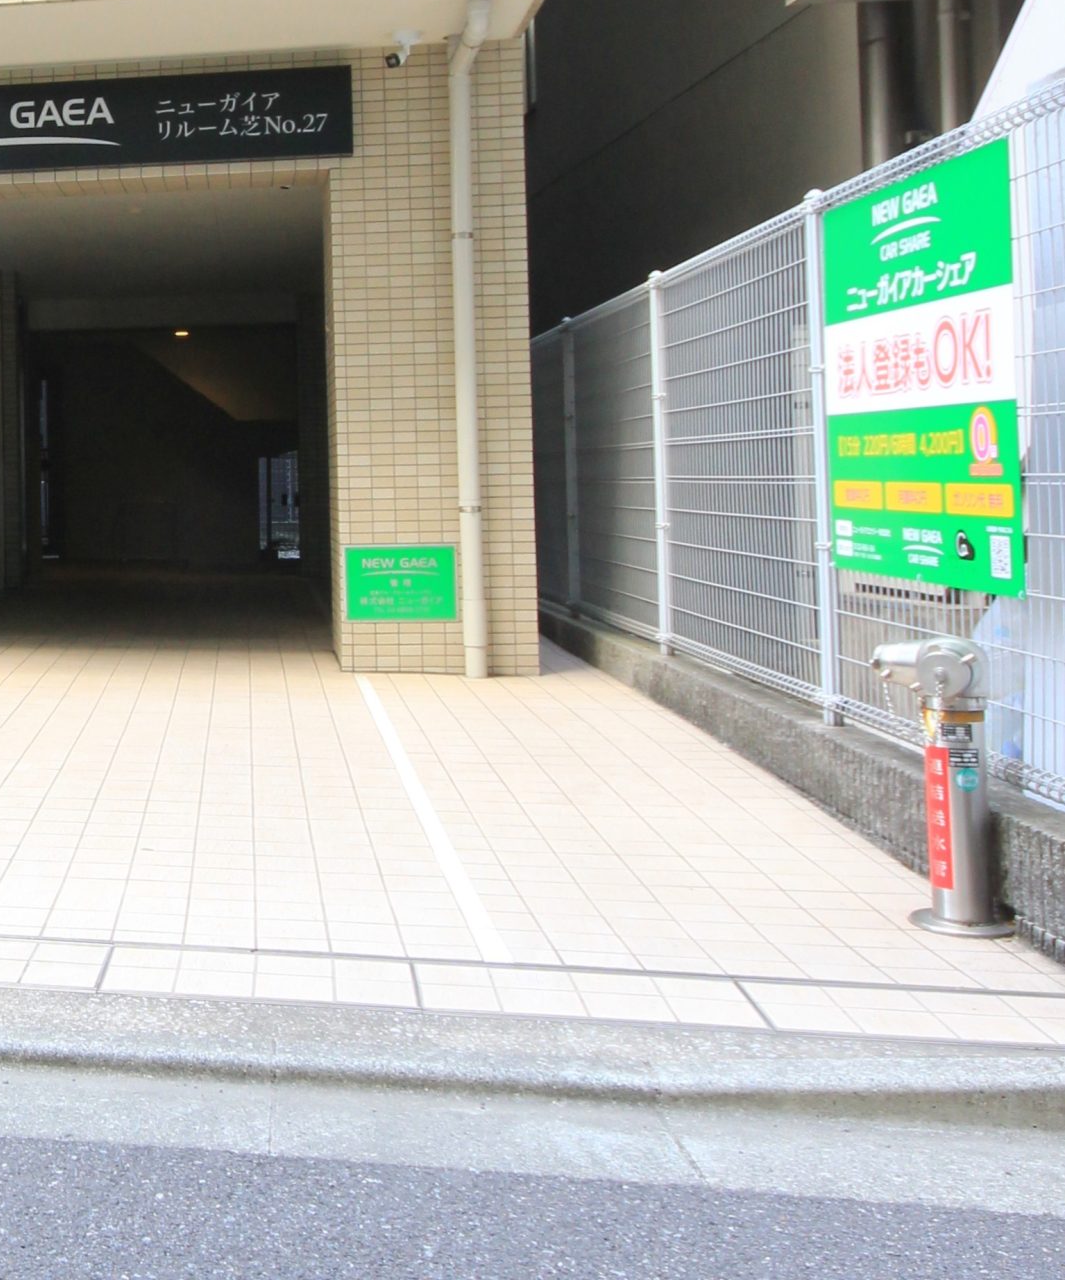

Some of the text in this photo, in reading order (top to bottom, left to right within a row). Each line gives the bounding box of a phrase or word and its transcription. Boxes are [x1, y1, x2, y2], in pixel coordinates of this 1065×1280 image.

[10, 97, 115, 129] GAEA
[155, 92, 280, 114] ニューガイア
[157, 113, 328, 140] リルーム芝No.27
[871, 181, 938, 227] NEW GAEA
[880, 230, 931, 261] CAR SHARE
[846, 251, 977, 312] ニューガイアカーシェア
[362, 557, 438, 568] NEW GAEA
